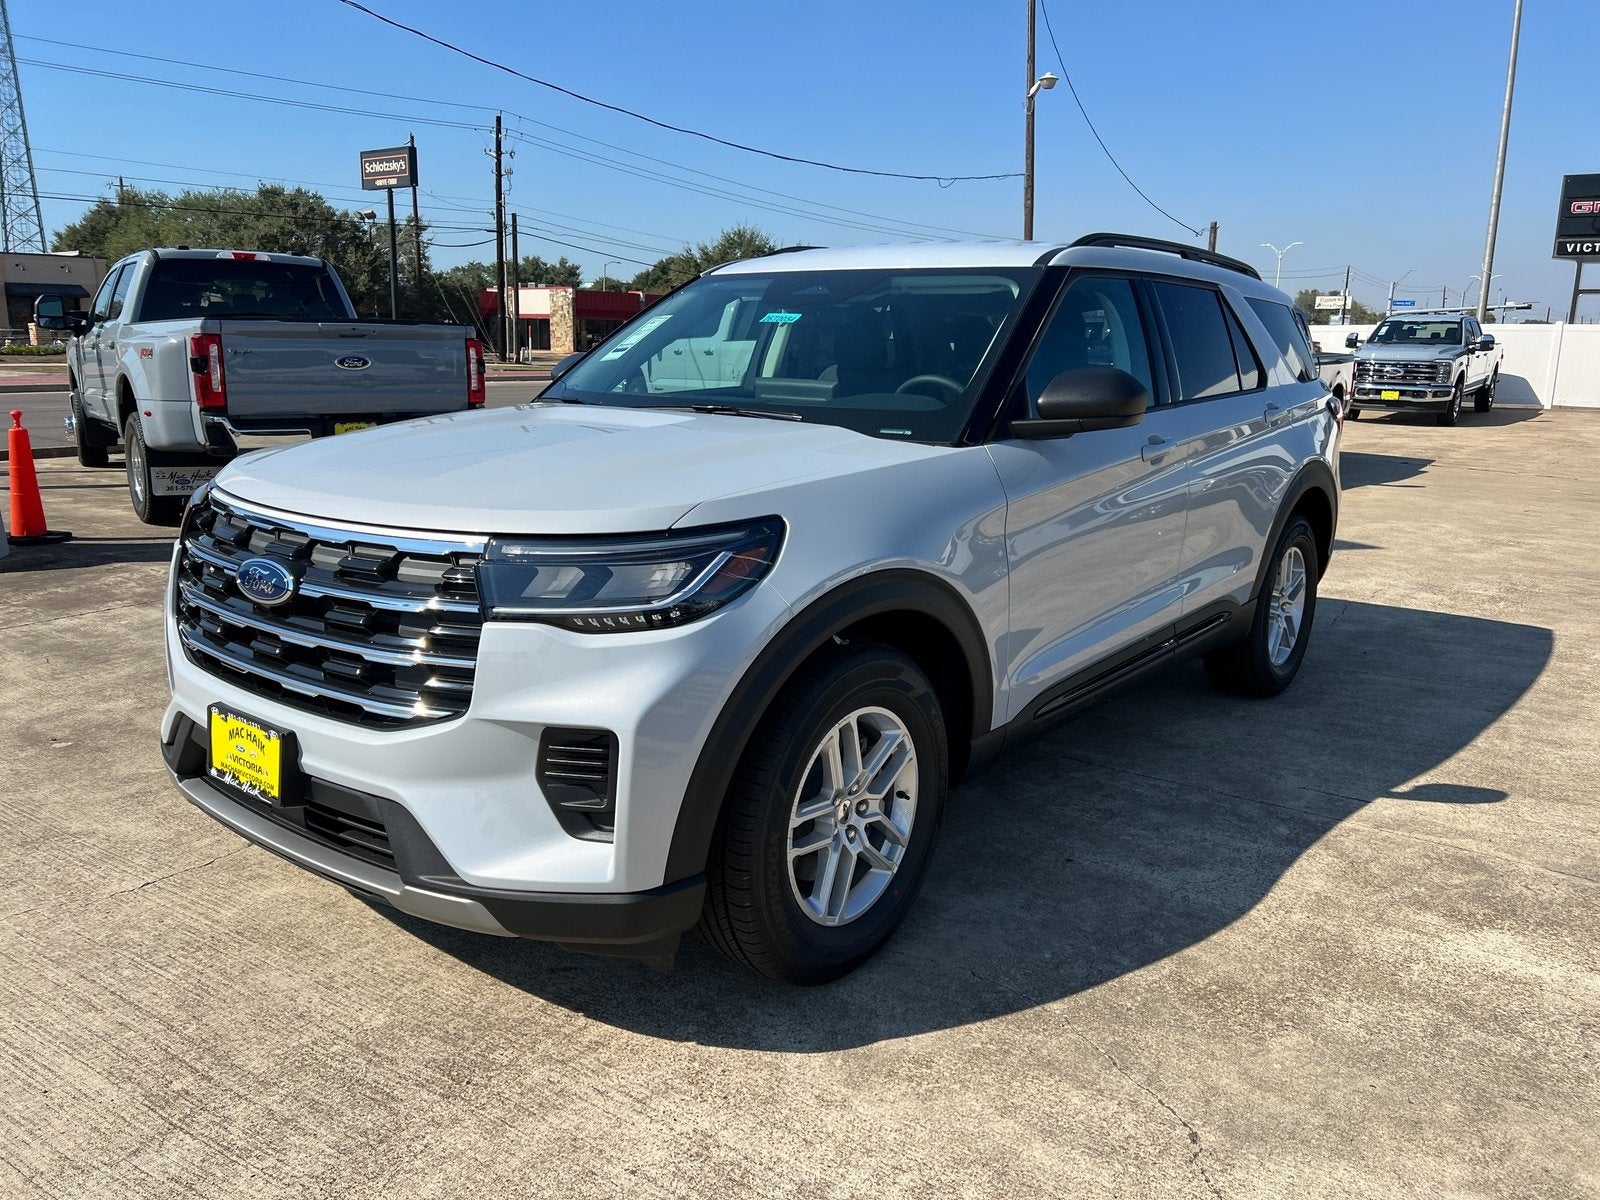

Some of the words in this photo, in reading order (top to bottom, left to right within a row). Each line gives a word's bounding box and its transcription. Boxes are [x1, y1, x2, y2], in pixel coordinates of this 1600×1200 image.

[365, 160, 405, 173] Schlotzsky's
[1566, 243, 1600, 253] VICT
[343, 358, 364, 367] Ford
[244, 566, 277, 595] Ford
[228, 726, 245, 741] MAC
[245, 728, 265, 755] HAIK
[231, 753, 263, 774] VICTORIA
[223, 772, 241, 787] Mac
[240, 780, 266, 798] Haik
